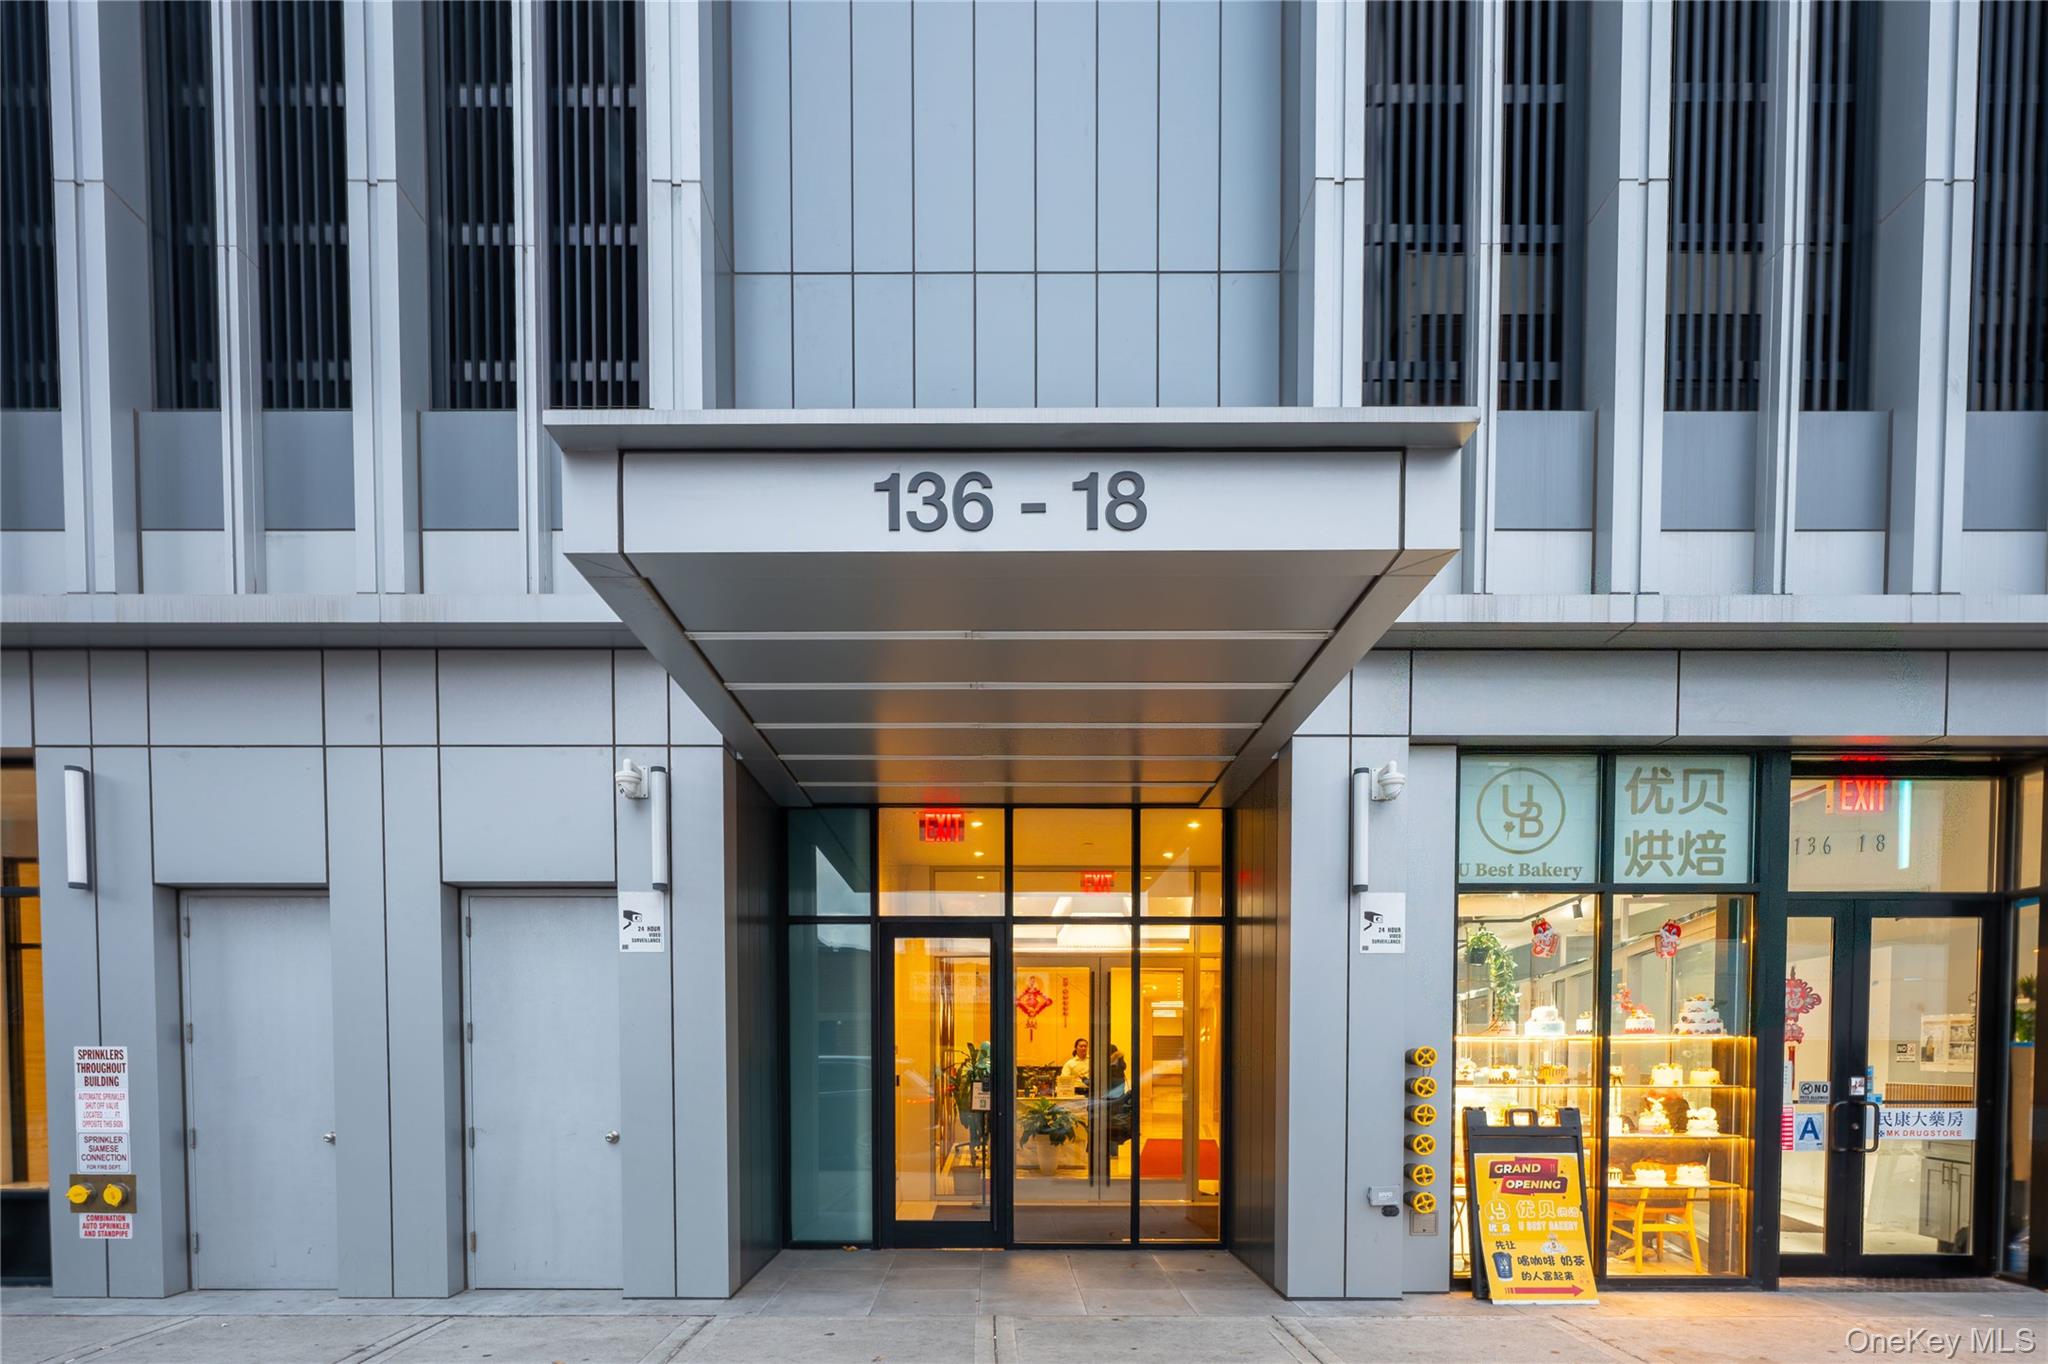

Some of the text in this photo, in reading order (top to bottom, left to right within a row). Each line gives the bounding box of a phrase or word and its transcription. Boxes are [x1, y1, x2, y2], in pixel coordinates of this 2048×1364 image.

[874, 471, 994, 532] 136
[1072, 471, 1147, 532] 18
[1624, 766, 1728, 815] 优贝
[1841, 779, 1889, 812] EXIT
[924, 813, 962, 842] EXIT
[1794, 834, 1885, 855] 136 18
[1624, 829, 1727, 877] 烘焙
[1459, 862, 1584, 880] U Best Bakery
[77, 1049, 125, 1060] SPRINKLERS
[76, 1062, 127, 1073] THROUGHOUT
[83, 1075, 120, 1087] BUILDING
[1814, 1084, 1828, 1093] NO
[83, 1111, 103, 1119] LOCATED
[1880, 1110, 1964, 1127] 民康大藥房
[82, 1120, 124, 1128] OPPOSITE THIS SIGN
[1798, 1116, 1820, 1141] A
[83, 1136, 124, 1144] SPRINKLER
[88, 1145, 119, 1153] SIAMESE
[81, 1153, 127, 1162] CONNECTION
[1494, 1164, 1541, 1174] GRAND
[1506, 1180, 1561, 1189] OPENING
